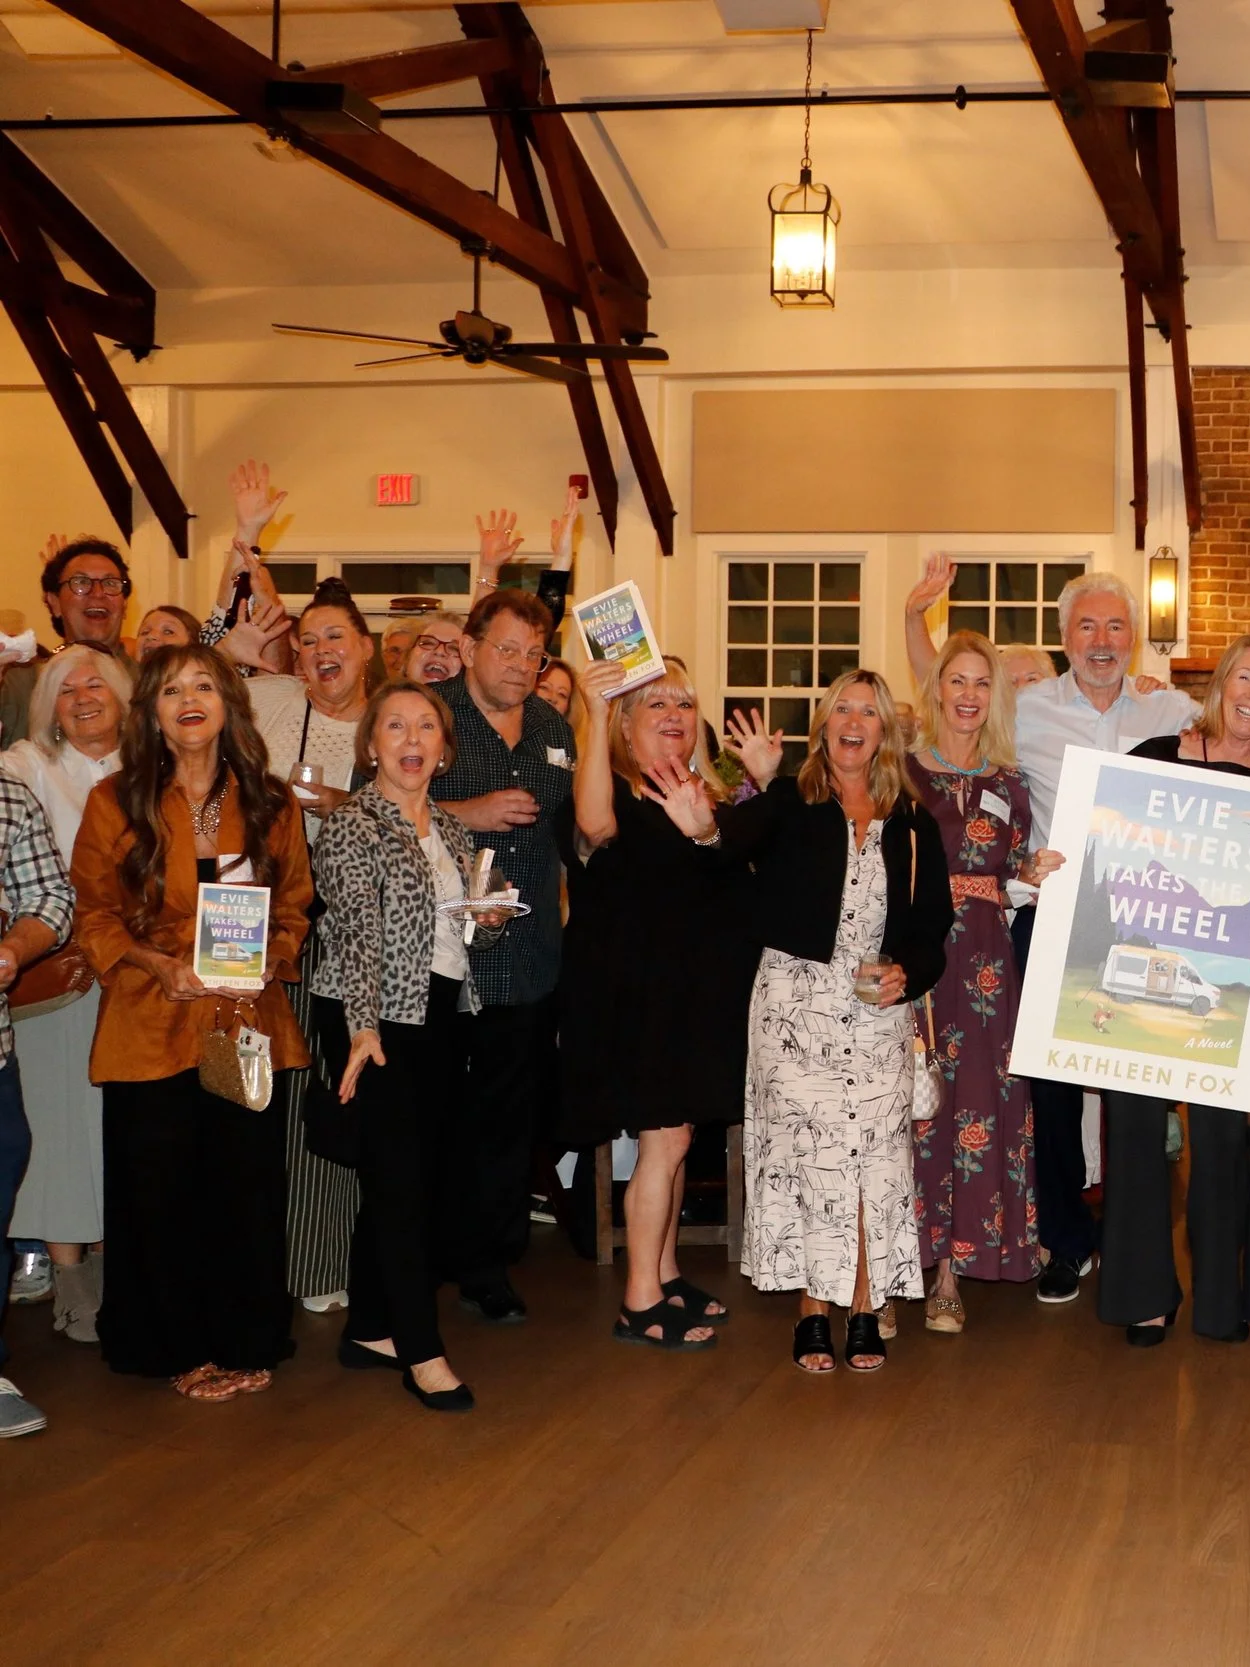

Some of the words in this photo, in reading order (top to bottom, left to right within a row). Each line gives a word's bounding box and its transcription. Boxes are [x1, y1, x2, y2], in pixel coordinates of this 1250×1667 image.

[377, 474, 412, 502] EXIT
[586, 602, 632, 629] WALTERS
[593, 597, 618, 615] EVIE
[593, 622, 616, 636] TAKES
[597, 623, 634, 646] WHEEL
[1147, 789, 1232, 830] EVIE
[1109, 862, 1185, 893] TAKES
[1198, 877, 1243, 901] THE
[221, 893, 249, 904] EVIE
[205, 903, 262, 917] WALTERS
[1109, 894, 1230, 942] WHEEL
[210, 916, 237, 926] TAKES
[211, 927, 254, 939] WHEEL
[1184, 1038, 1195, 1048] A
[1197, 1037, 1233, 1049] Novel
[1047, 1049, 1172, 1086] KATHLEEN
[1185, 1071, 1236, 1096] FOX
